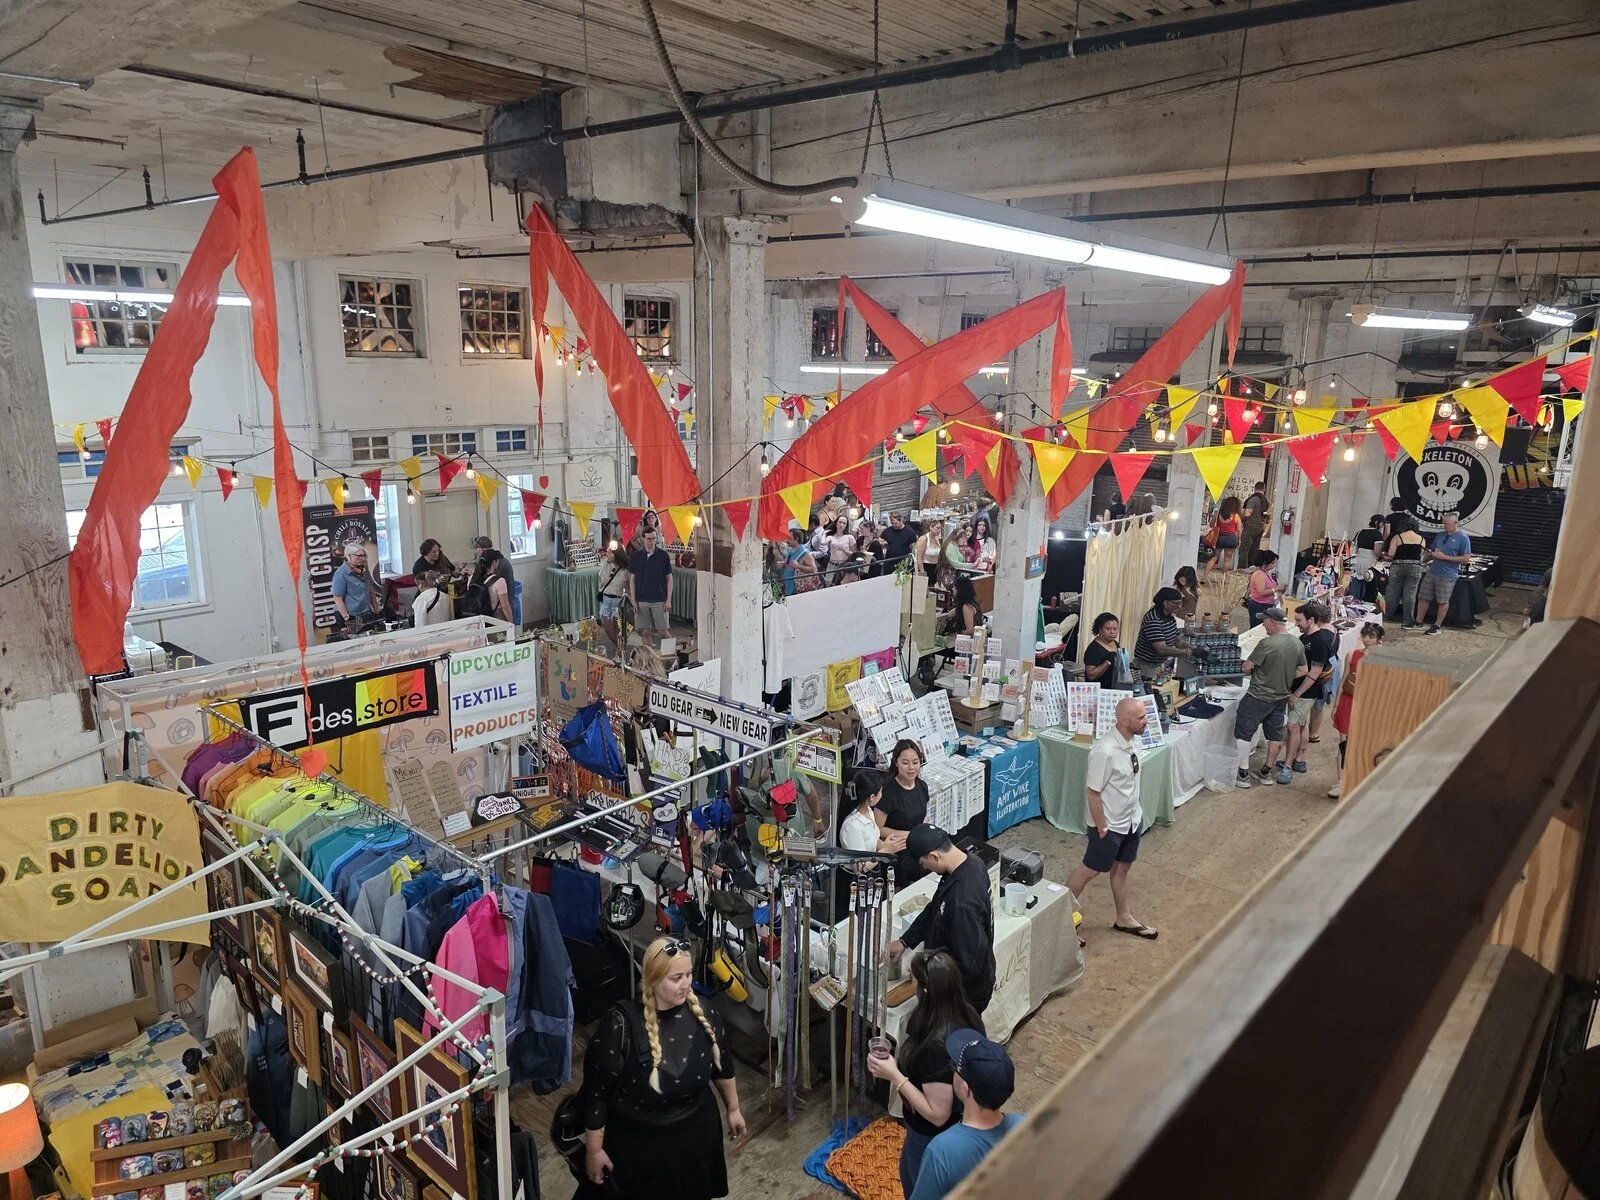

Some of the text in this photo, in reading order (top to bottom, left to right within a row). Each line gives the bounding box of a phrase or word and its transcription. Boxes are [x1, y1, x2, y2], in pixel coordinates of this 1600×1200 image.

[1422, 450, 1473, 468] KELETON
[1230, 476, 1255, 484] HIGH
[1416, 504, 1461, 521] BAN
[334, 520, 372, 540] CHILI ROYALE
[305, 524, 337, 629] CHILI CRISP
[451, 646, 532, 675] UPCYCLED
[452, 682, 518, 711] TEXTILE
[453, 708, 536, 742] PRODUCTS
[651, 690, 668, 709] OLD
[670, 696, 693, 717] GEAR
[720, 711, 740, 732] NEW
[742, 719, 768, 742] GEAR
[996, 794, 1030, 821] ILLUSTRATION
[997, 790, 1011, 808] AMY
[50, 811, 163, 842] DIRTY
[0, 843, 197, 892] ANDELION
